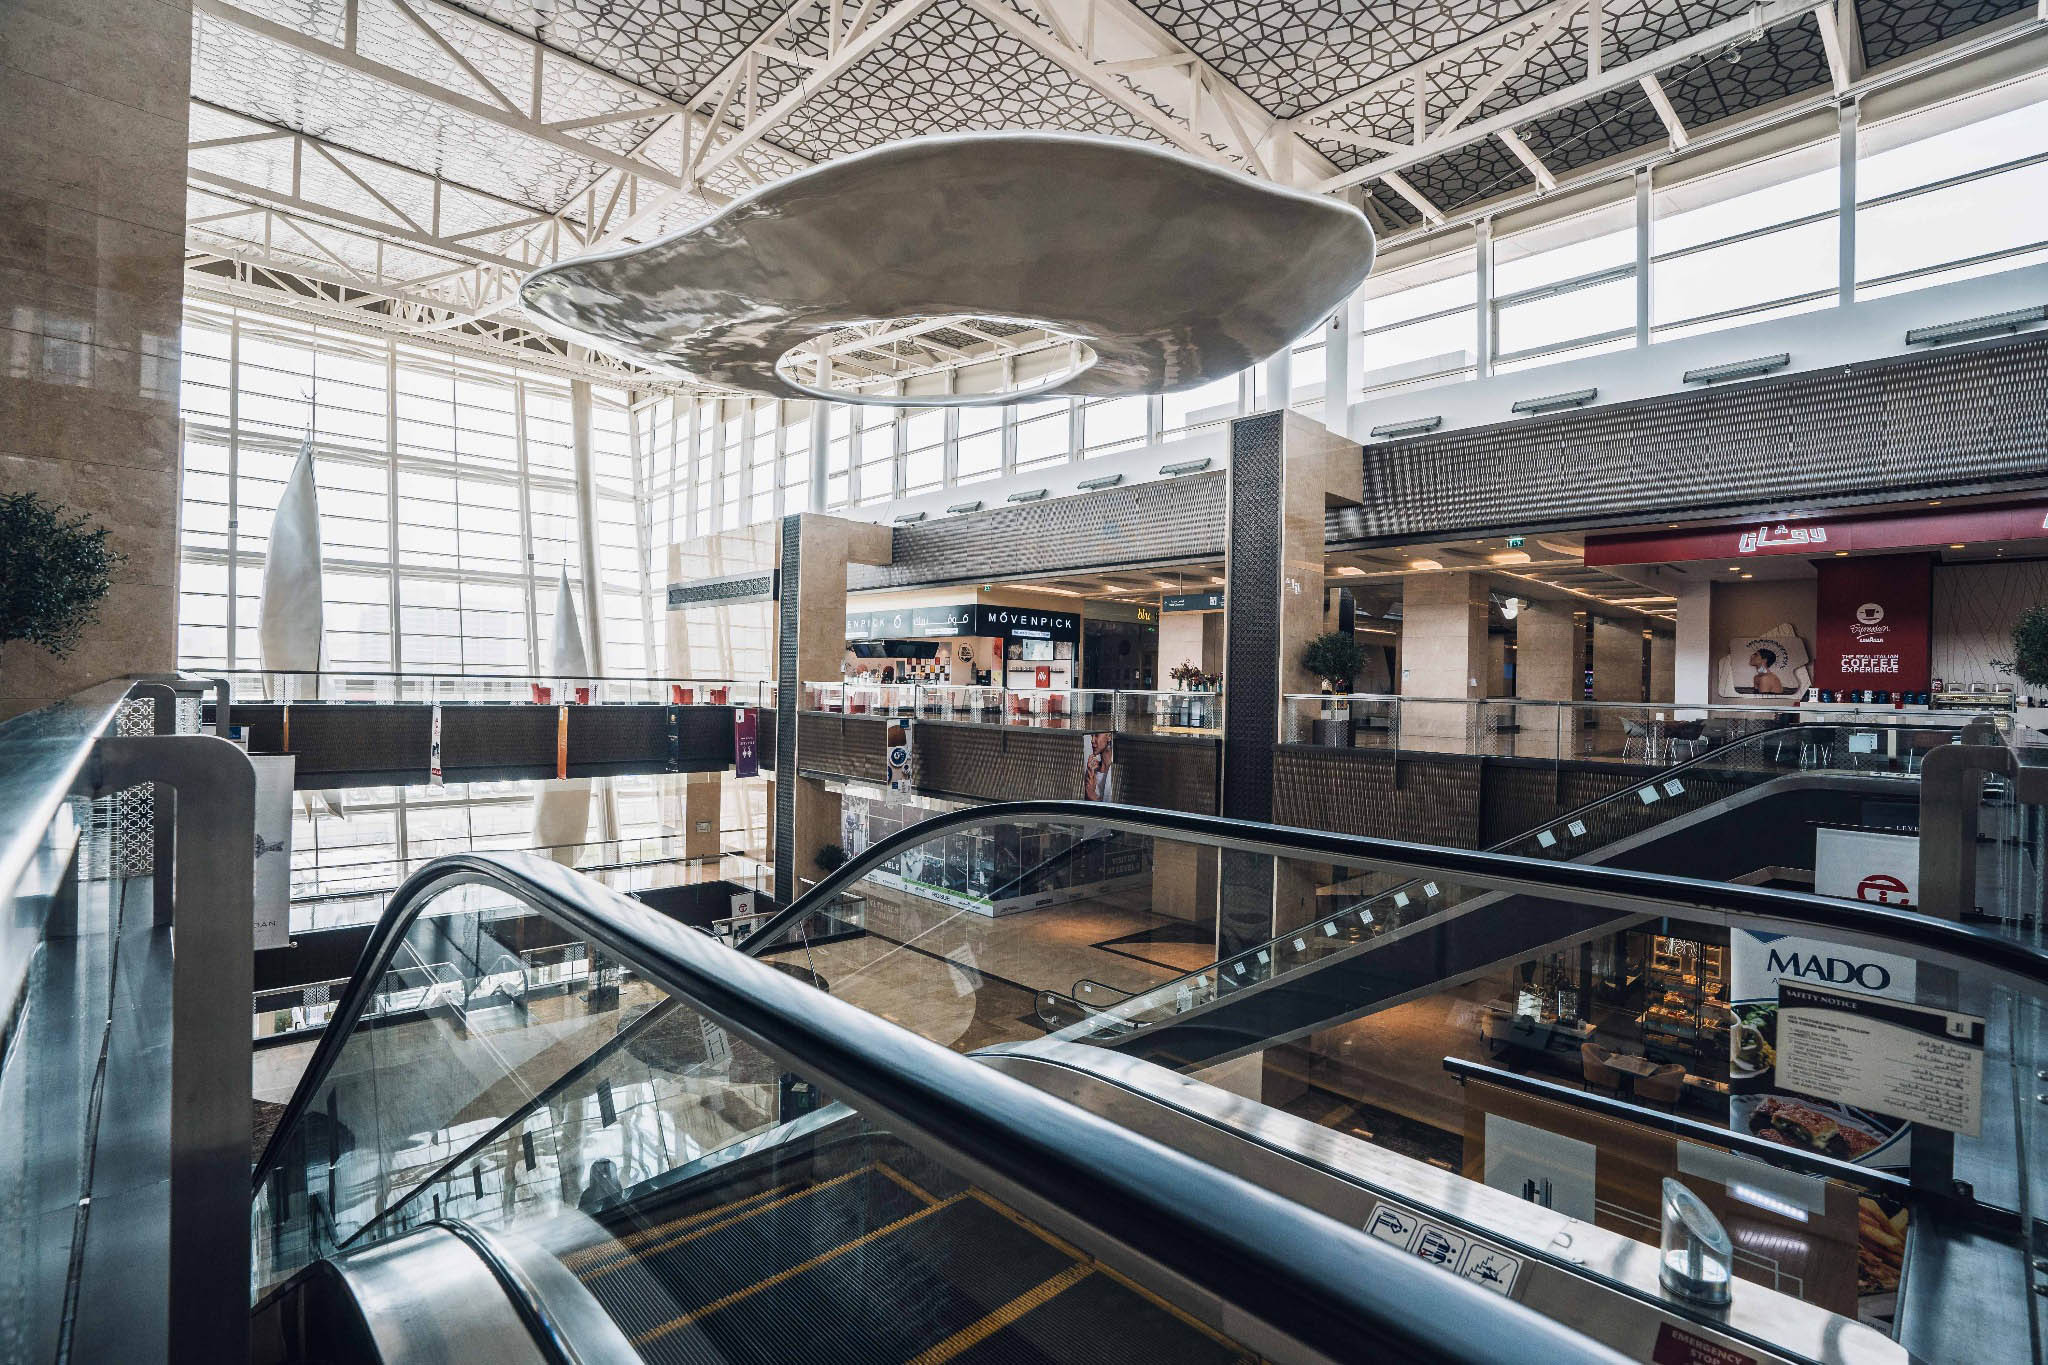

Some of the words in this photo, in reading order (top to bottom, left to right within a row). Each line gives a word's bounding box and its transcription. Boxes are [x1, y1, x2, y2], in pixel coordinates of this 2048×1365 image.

[1841, 658, 1899, 667] COFFEE
[1767, 948, 1891, 990] MADO
[1786, 989, 1818, 1001] SAFETY
[1820, 996, 1857, 1009] NOTICE
[1671, 1330, 1743, 1365] EMERGENCY
[1689, 1348, 1721, 1365] STOP
